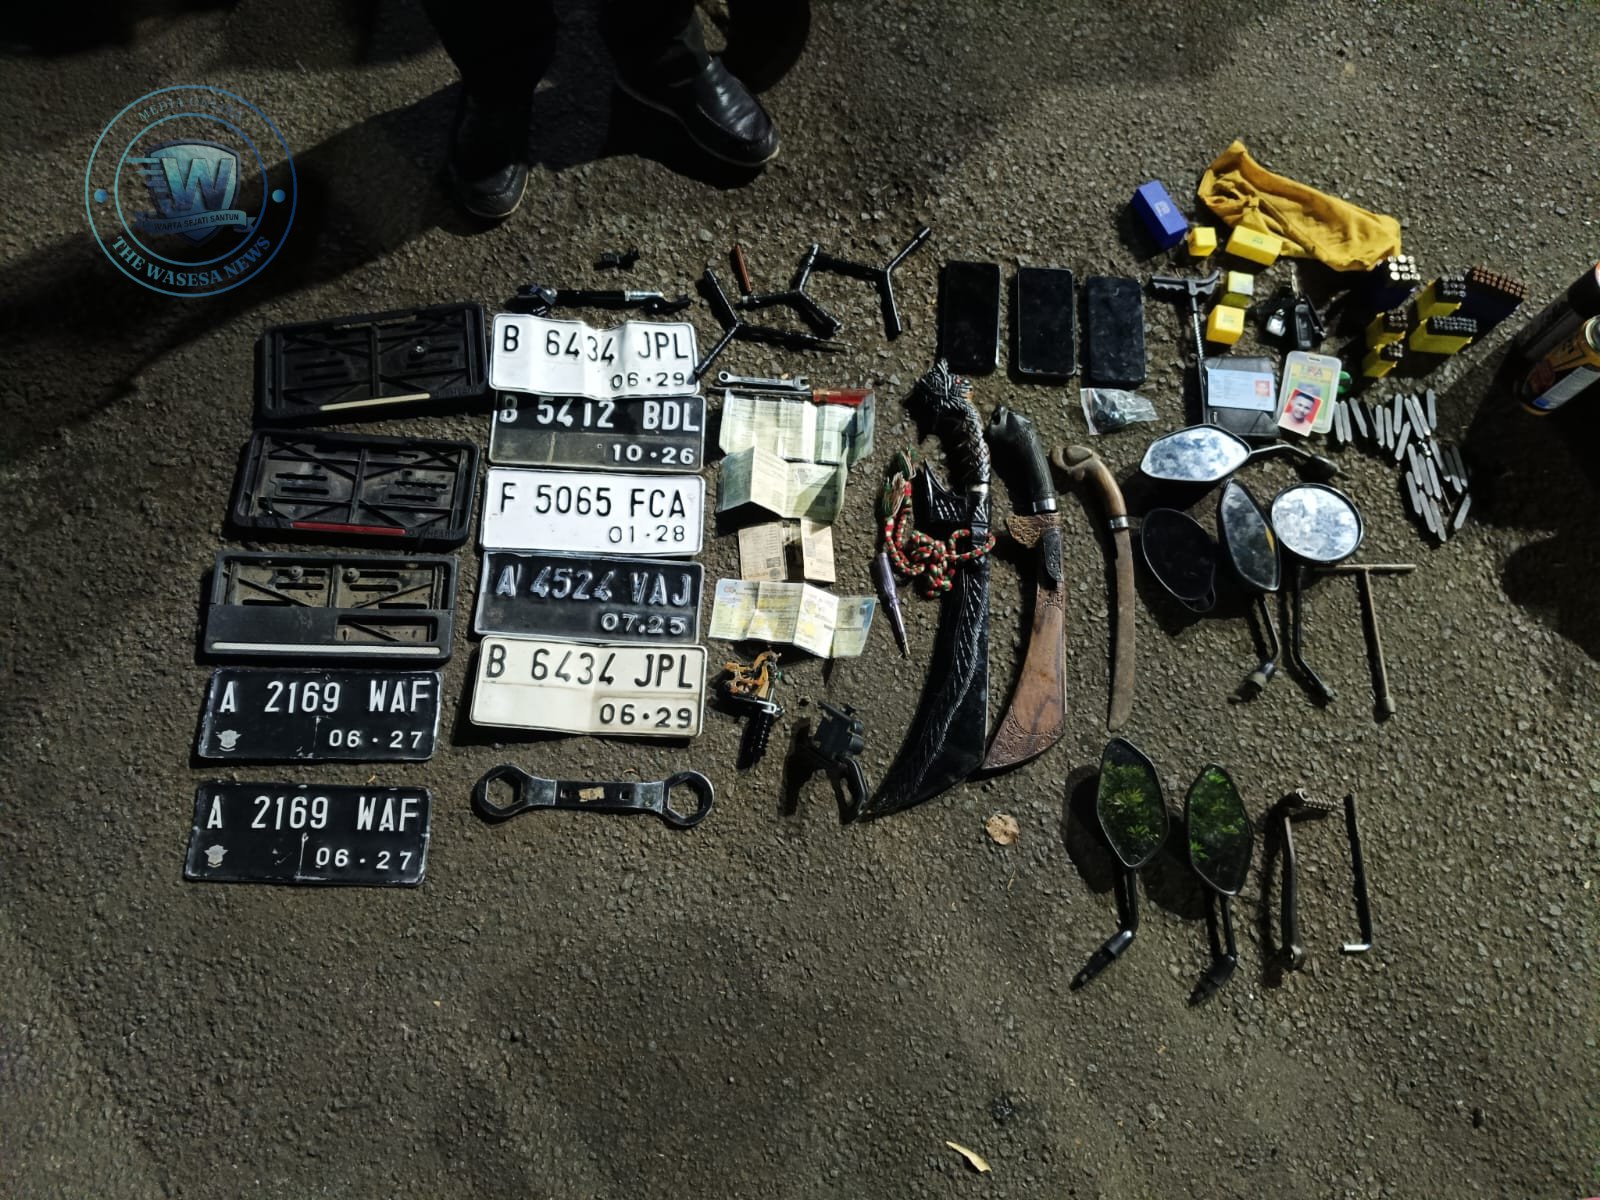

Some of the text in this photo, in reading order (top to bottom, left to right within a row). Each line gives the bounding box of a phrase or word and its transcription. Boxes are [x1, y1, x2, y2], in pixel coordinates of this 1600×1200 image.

[504, 324, 689, 367] B 6434 JPL
[499, 396, 518, 423] B
[536, 399, 615, 428] 5412
[642, 401, 700, 432] BDL
[500, 482, 686, 518] F 5065 FCA
[496, 564, 692, 606] A 4524 VAJ
[486, 644, 693, 689] B 6434 JPL
[219, 680, 431, 713] A 2169 WAF
[207, 795, 418, 832] A 2169 WAF
